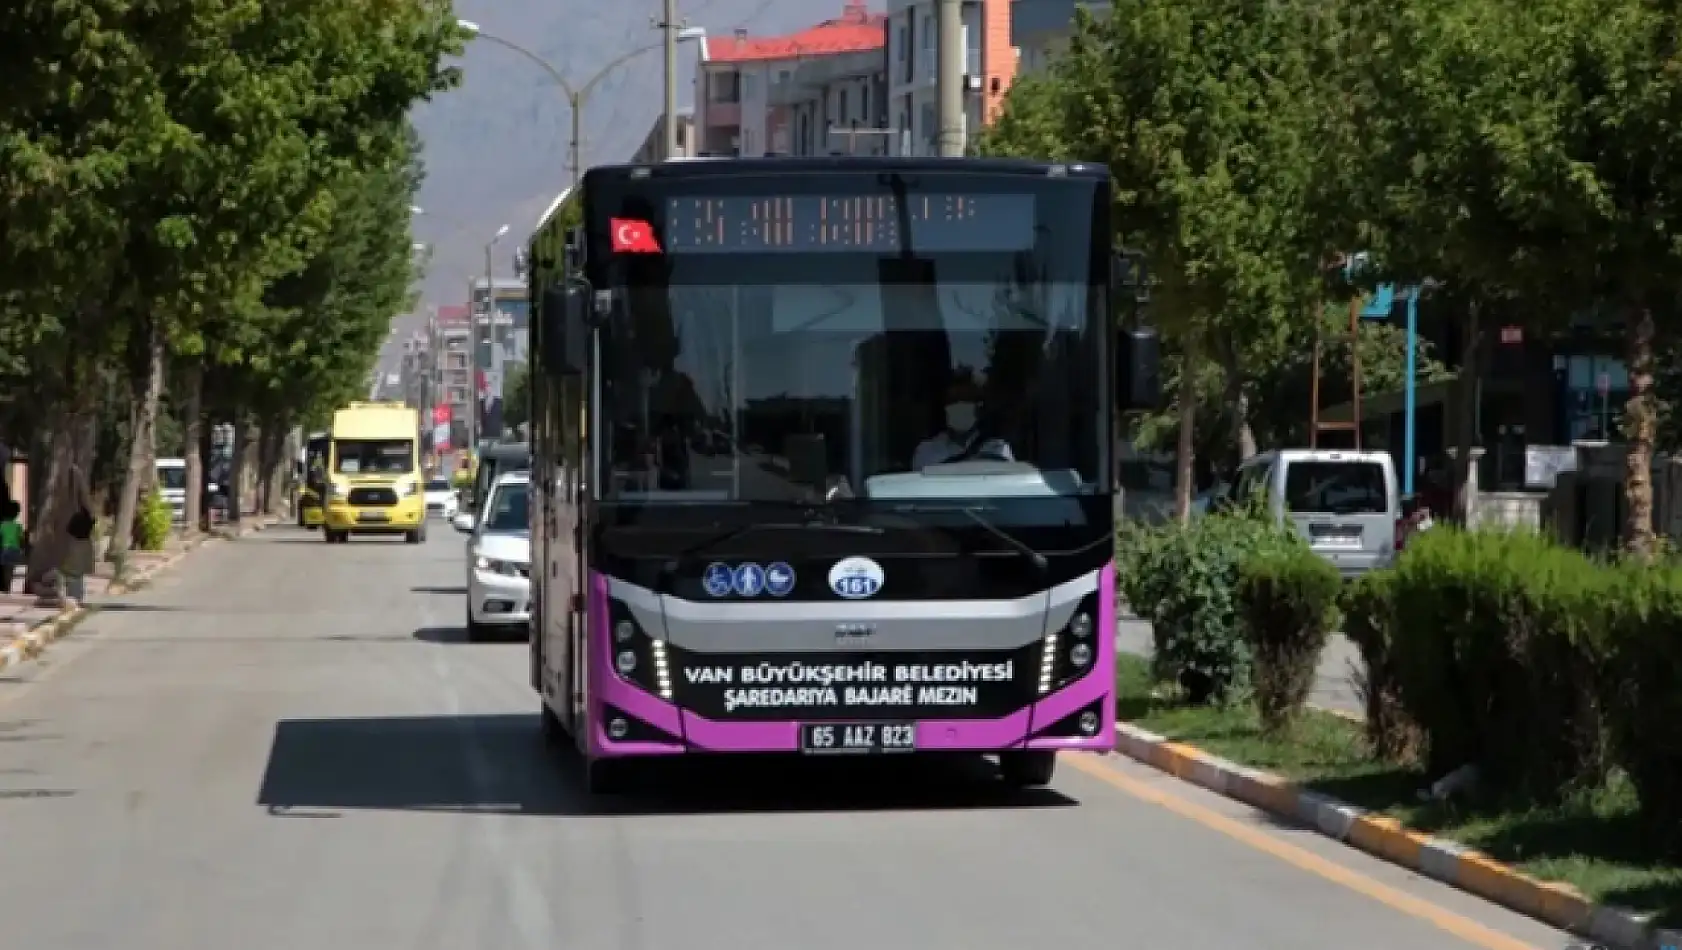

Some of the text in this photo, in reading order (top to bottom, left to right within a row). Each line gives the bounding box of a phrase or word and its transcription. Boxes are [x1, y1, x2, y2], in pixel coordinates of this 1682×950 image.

[684, 660, 1013, 686] VAN BÜYÜKŞEHİR BELEDİYESİ
[812, 726, 835, 748] 65
[843, 726, 875, 748] AAZ
